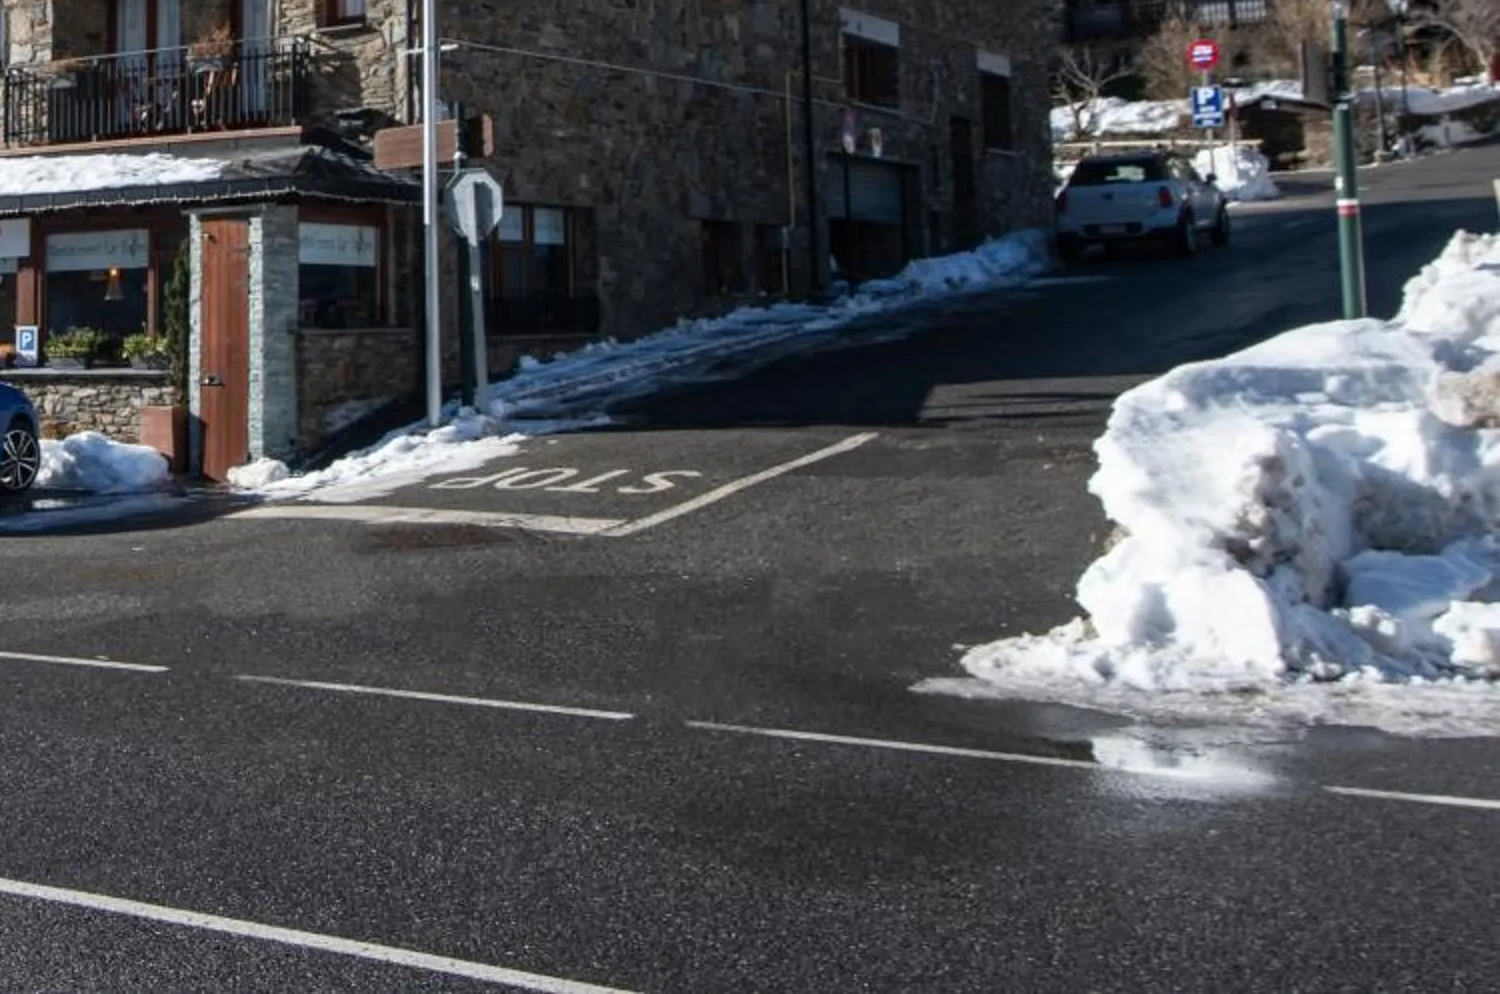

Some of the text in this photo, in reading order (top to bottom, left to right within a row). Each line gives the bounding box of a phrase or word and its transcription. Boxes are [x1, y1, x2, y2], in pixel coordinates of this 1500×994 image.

[1198, 88, 1214, 104] P
[22, 331, 32, 348] P
[426, 467, 702, 493] STOP
